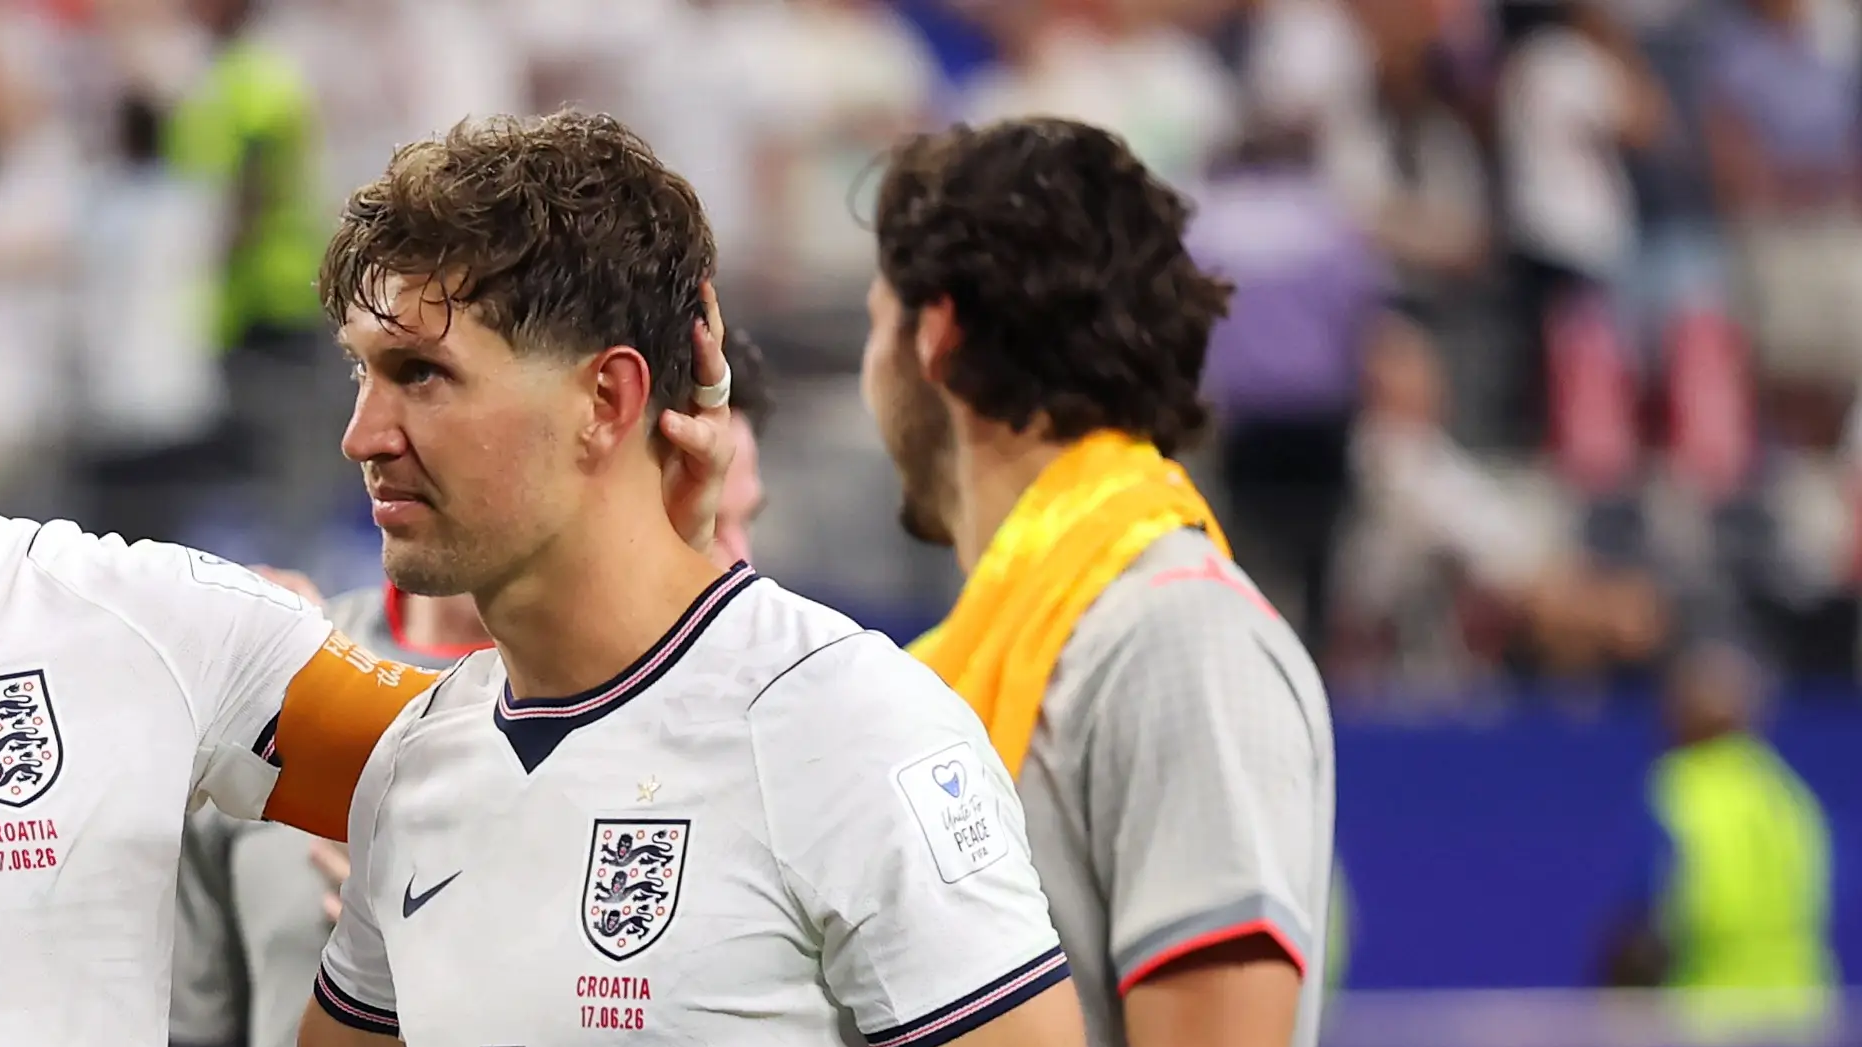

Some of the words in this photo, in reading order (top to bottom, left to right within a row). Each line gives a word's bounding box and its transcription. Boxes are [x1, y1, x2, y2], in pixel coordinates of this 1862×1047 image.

[954, 817, 990, 852] PEACE
[576, 976, 651, 1000] CROATIA
[581, 1005, 644, 1030] 17.06.26
